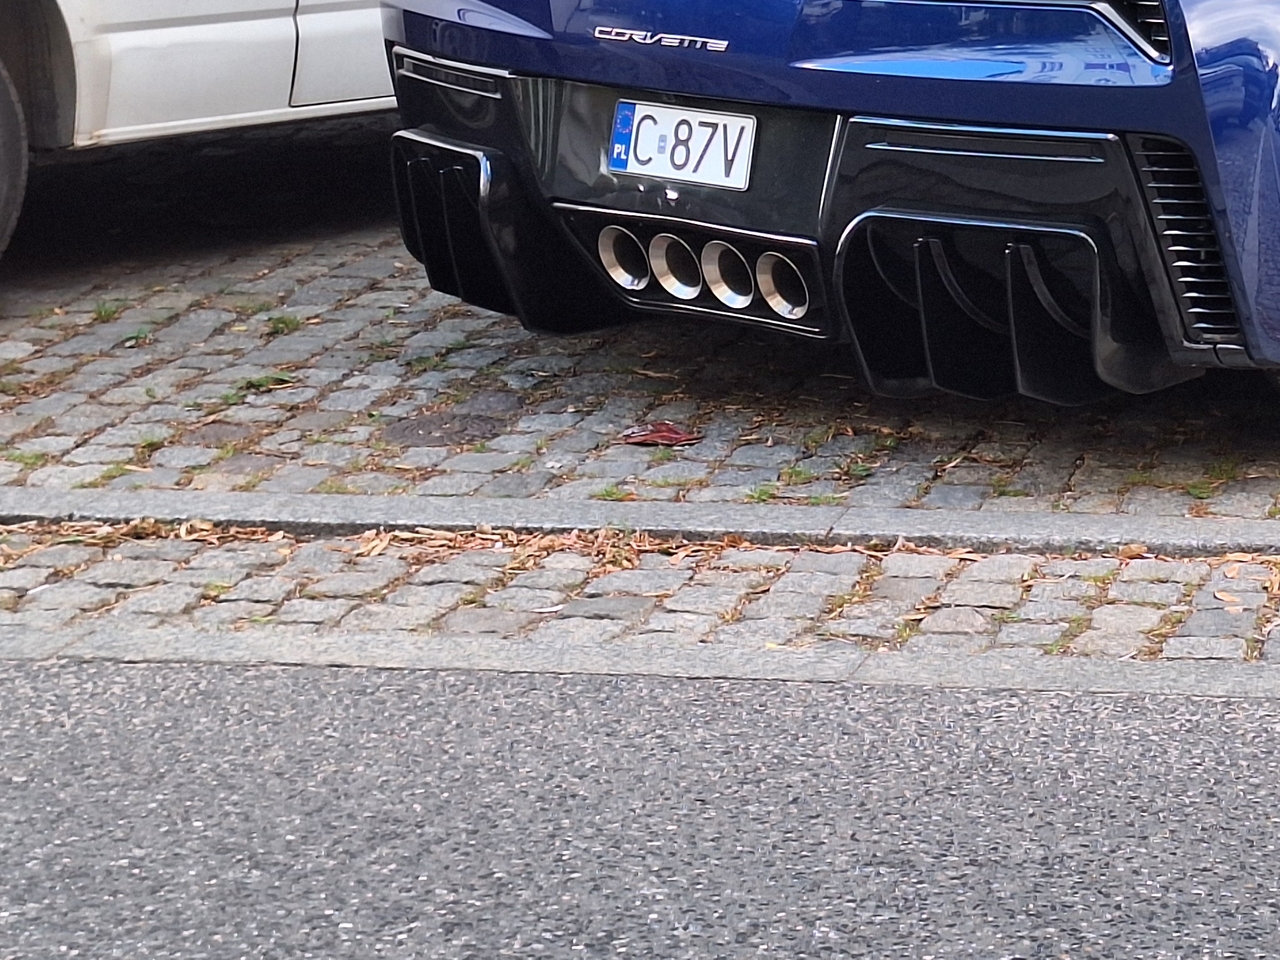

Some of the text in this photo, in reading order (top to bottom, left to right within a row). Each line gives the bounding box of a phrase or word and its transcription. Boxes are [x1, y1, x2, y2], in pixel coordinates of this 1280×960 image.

[594, 26, 729, 51] CORVETTE
[613, 144, 627, 160] PL
[633, 114, 746, 178] C 87V
